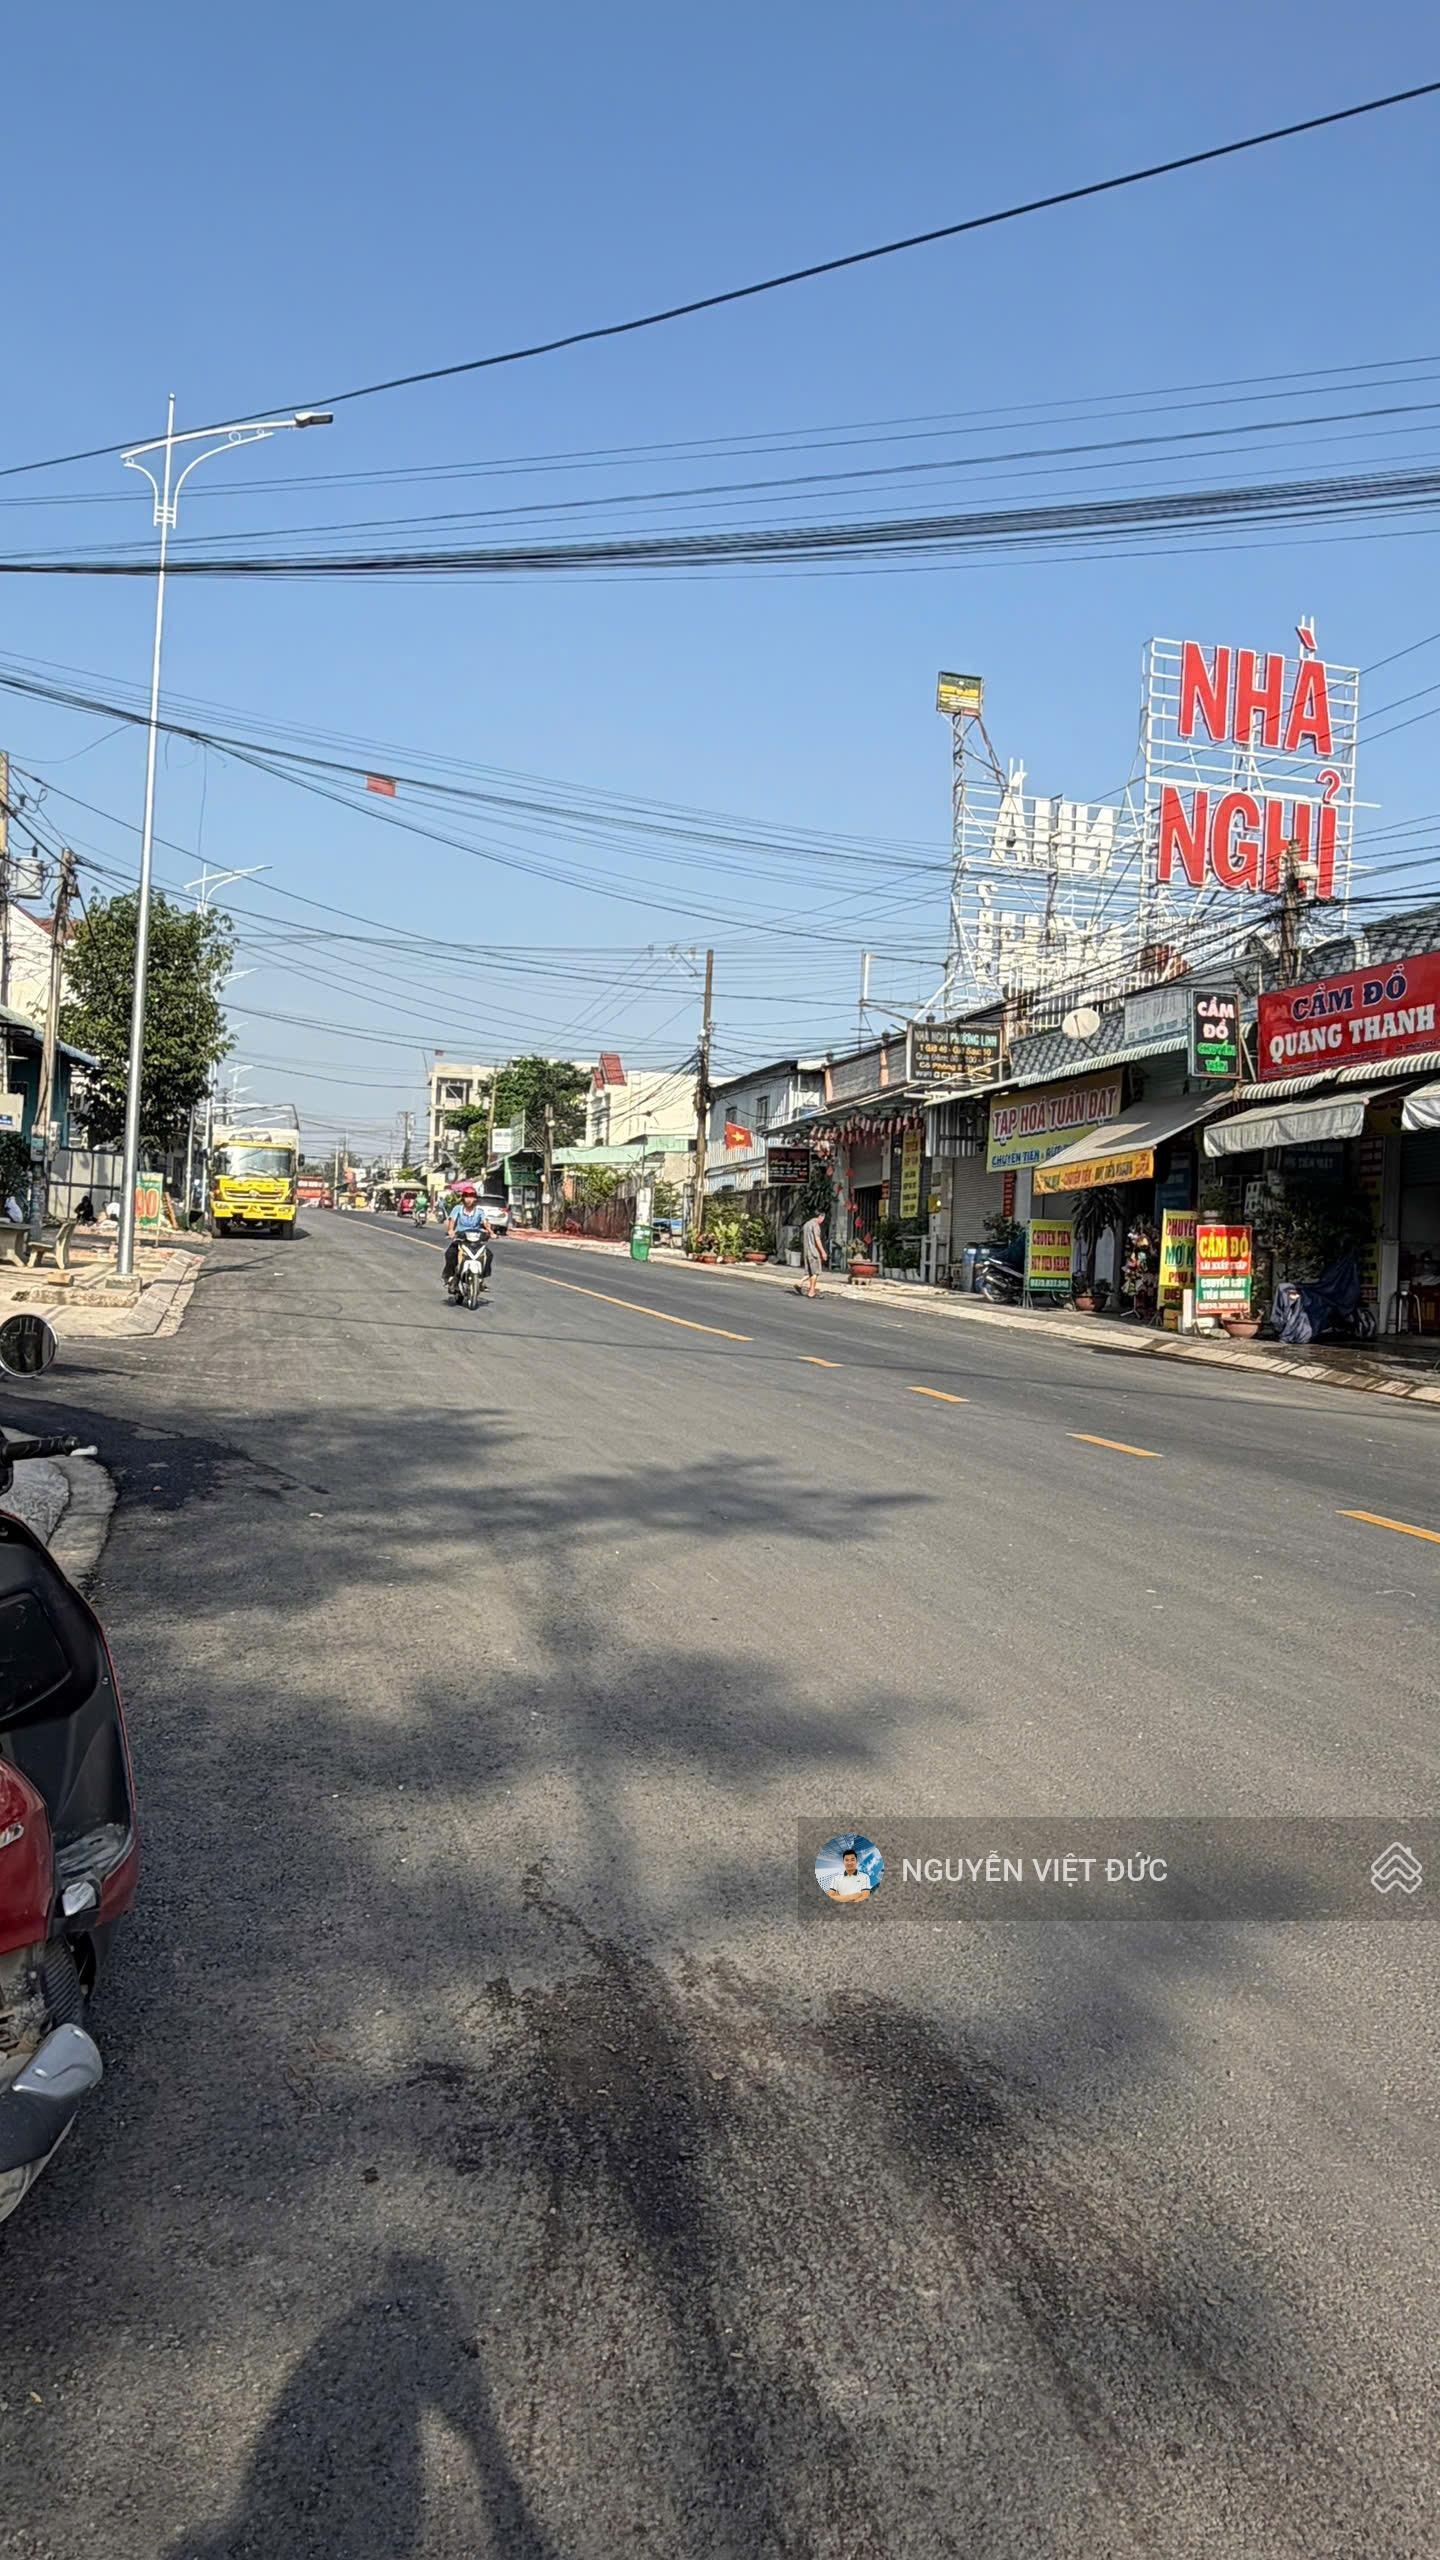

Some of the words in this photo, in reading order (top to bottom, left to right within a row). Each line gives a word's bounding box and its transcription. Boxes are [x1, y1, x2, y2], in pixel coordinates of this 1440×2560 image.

[1179, 624, 1334, 756] NHÀ
[1157, 768, 1341, 902] NGHỈ
[1197, 996, 1235, 1019] CẦM
[1291, 983, 1354, 1021] CẦM
[1362, 963, 1408, 1007] ĐỒ
[1203, 1018, 1229, 1039] ĐỒ
[1269, 1023, 1343, 1064] QUANG
[1349, 1004, 1436, 1045] THANH
[992, 1107, 1018, 1145] TẠP
[1018, 1096, 1046, 1136] HOÁ
[1087, 1085, 1119, 1125] ĐẠT
[1199, 1226, 1228, 1258] CẦM
